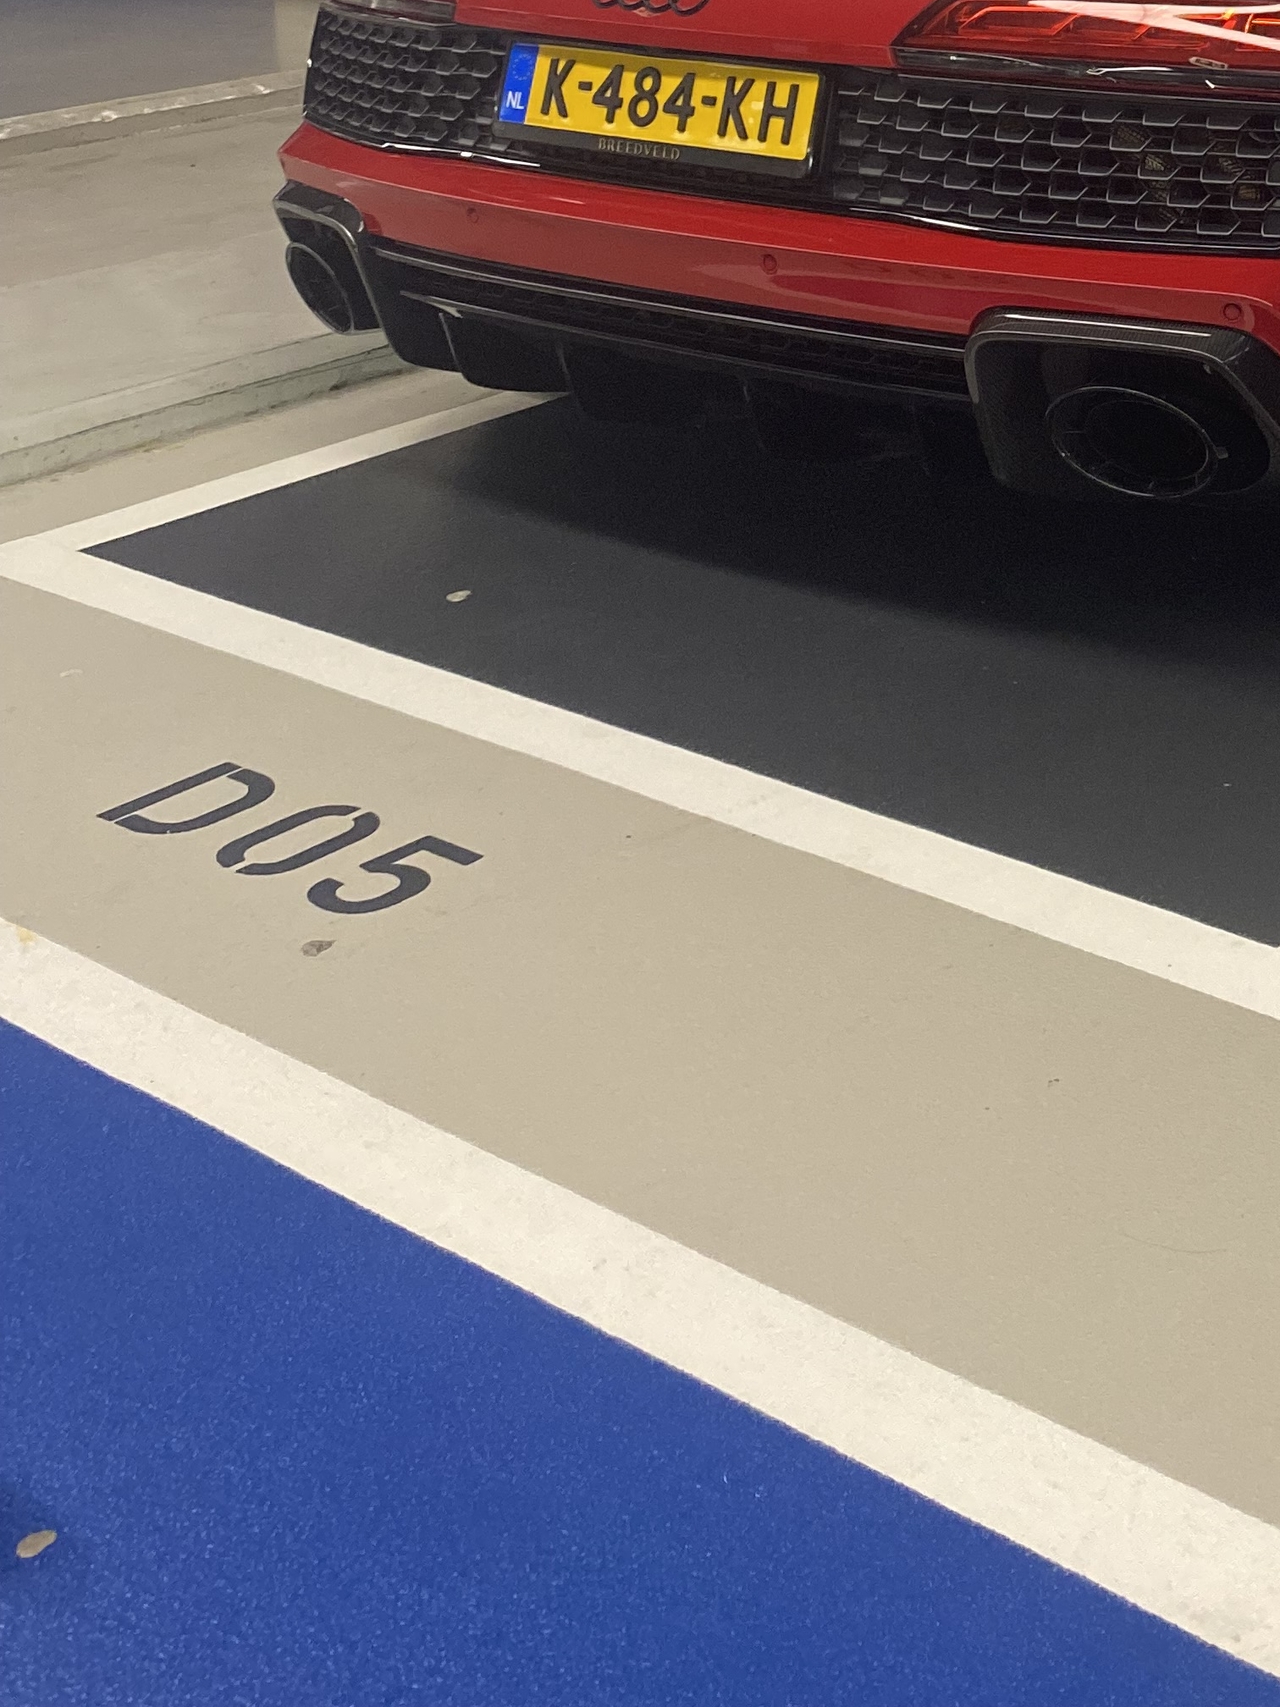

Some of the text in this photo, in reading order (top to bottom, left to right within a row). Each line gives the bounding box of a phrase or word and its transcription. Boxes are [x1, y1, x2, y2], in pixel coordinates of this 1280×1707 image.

[505, 90, 525, 109] NL
[540, 57, 800, 146] K-484-KH
[598, 137, 680, 160] BREEDVELD
[96, 761, 484, 914] D05
